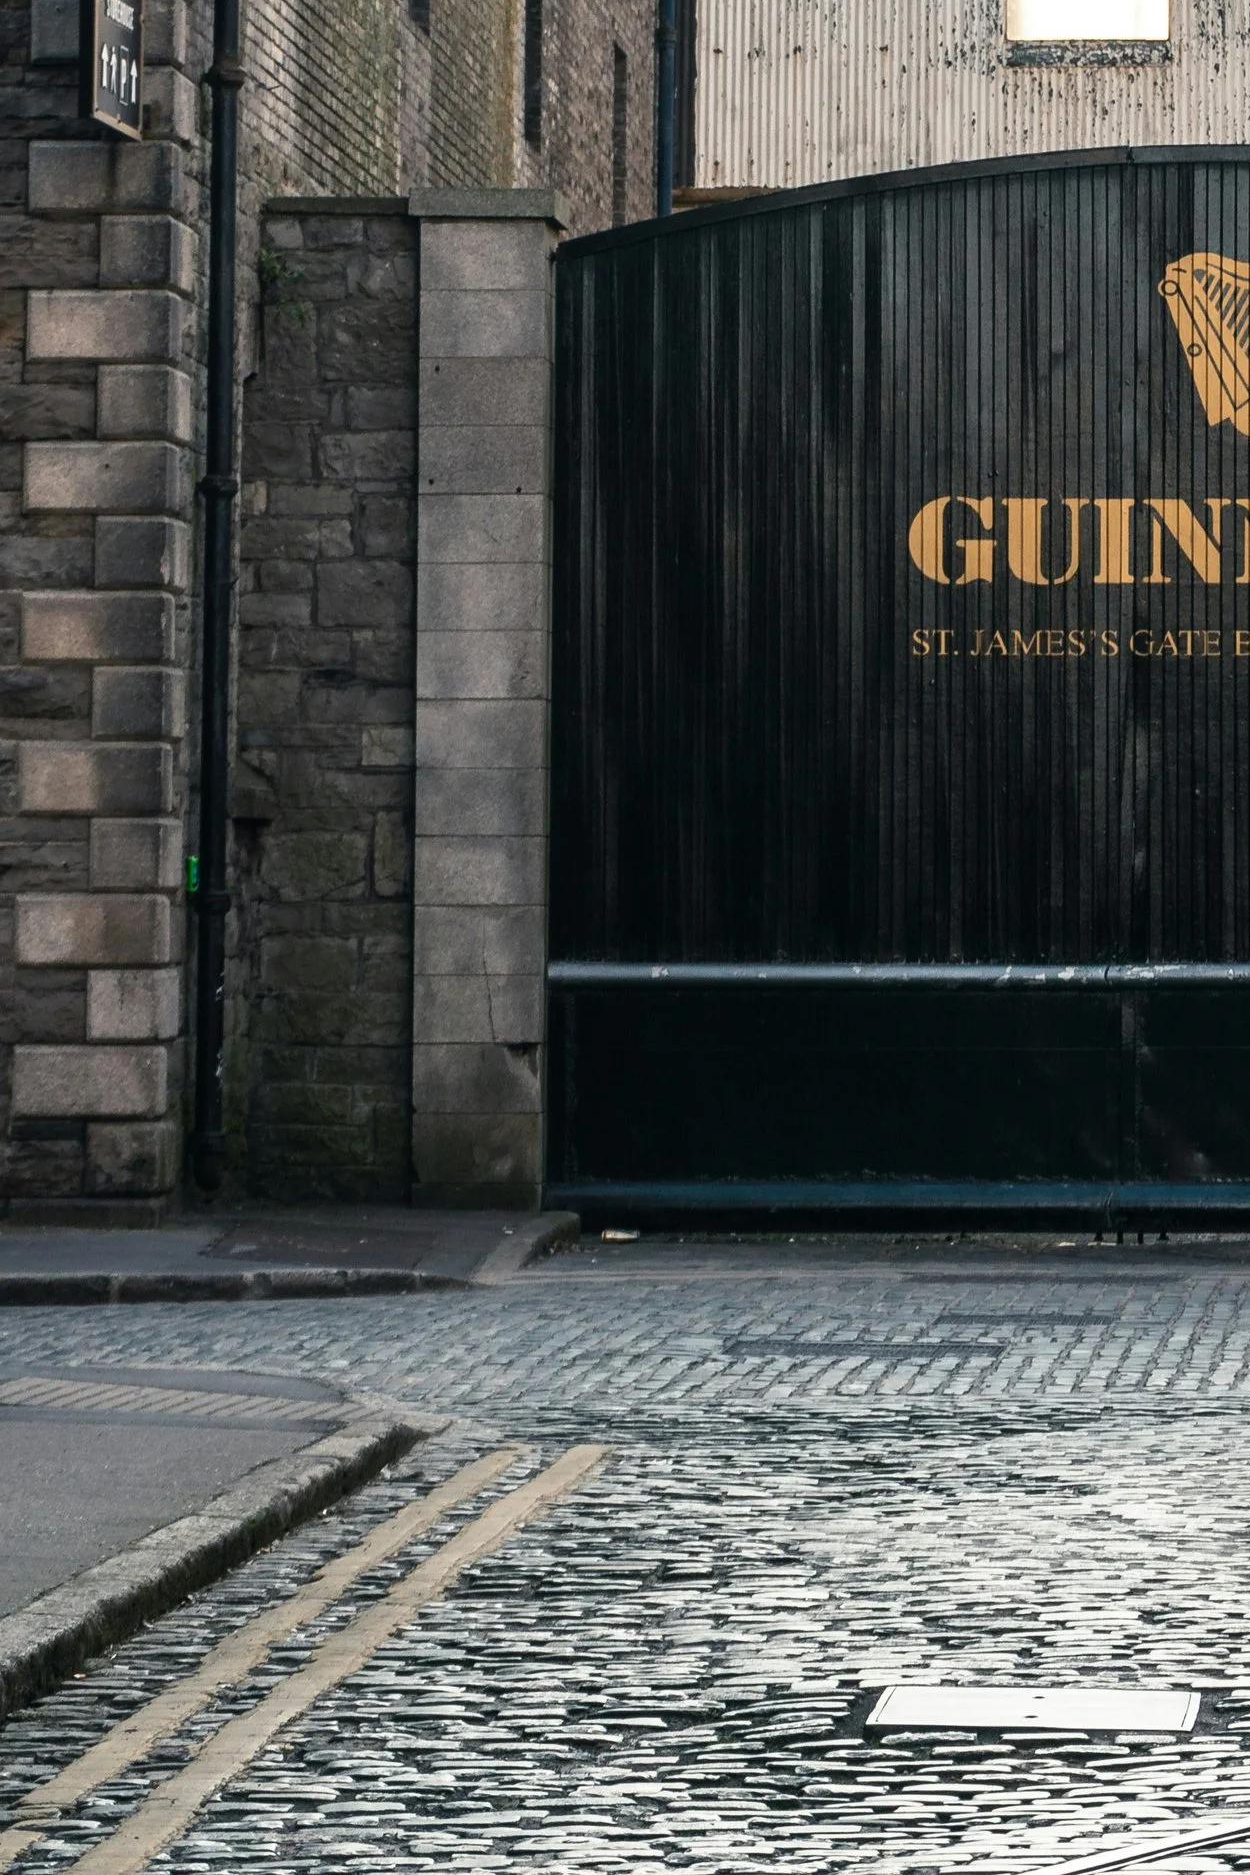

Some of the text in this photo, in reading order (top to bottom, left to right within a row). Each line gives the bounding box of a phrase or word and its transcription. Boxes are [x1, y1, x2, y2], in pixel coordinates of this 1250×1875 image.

[912, 629, 959, 656] ST.
[970, 629, 1119, 656] JAMES'S
[1129, 629, 1221, 657] GATE
